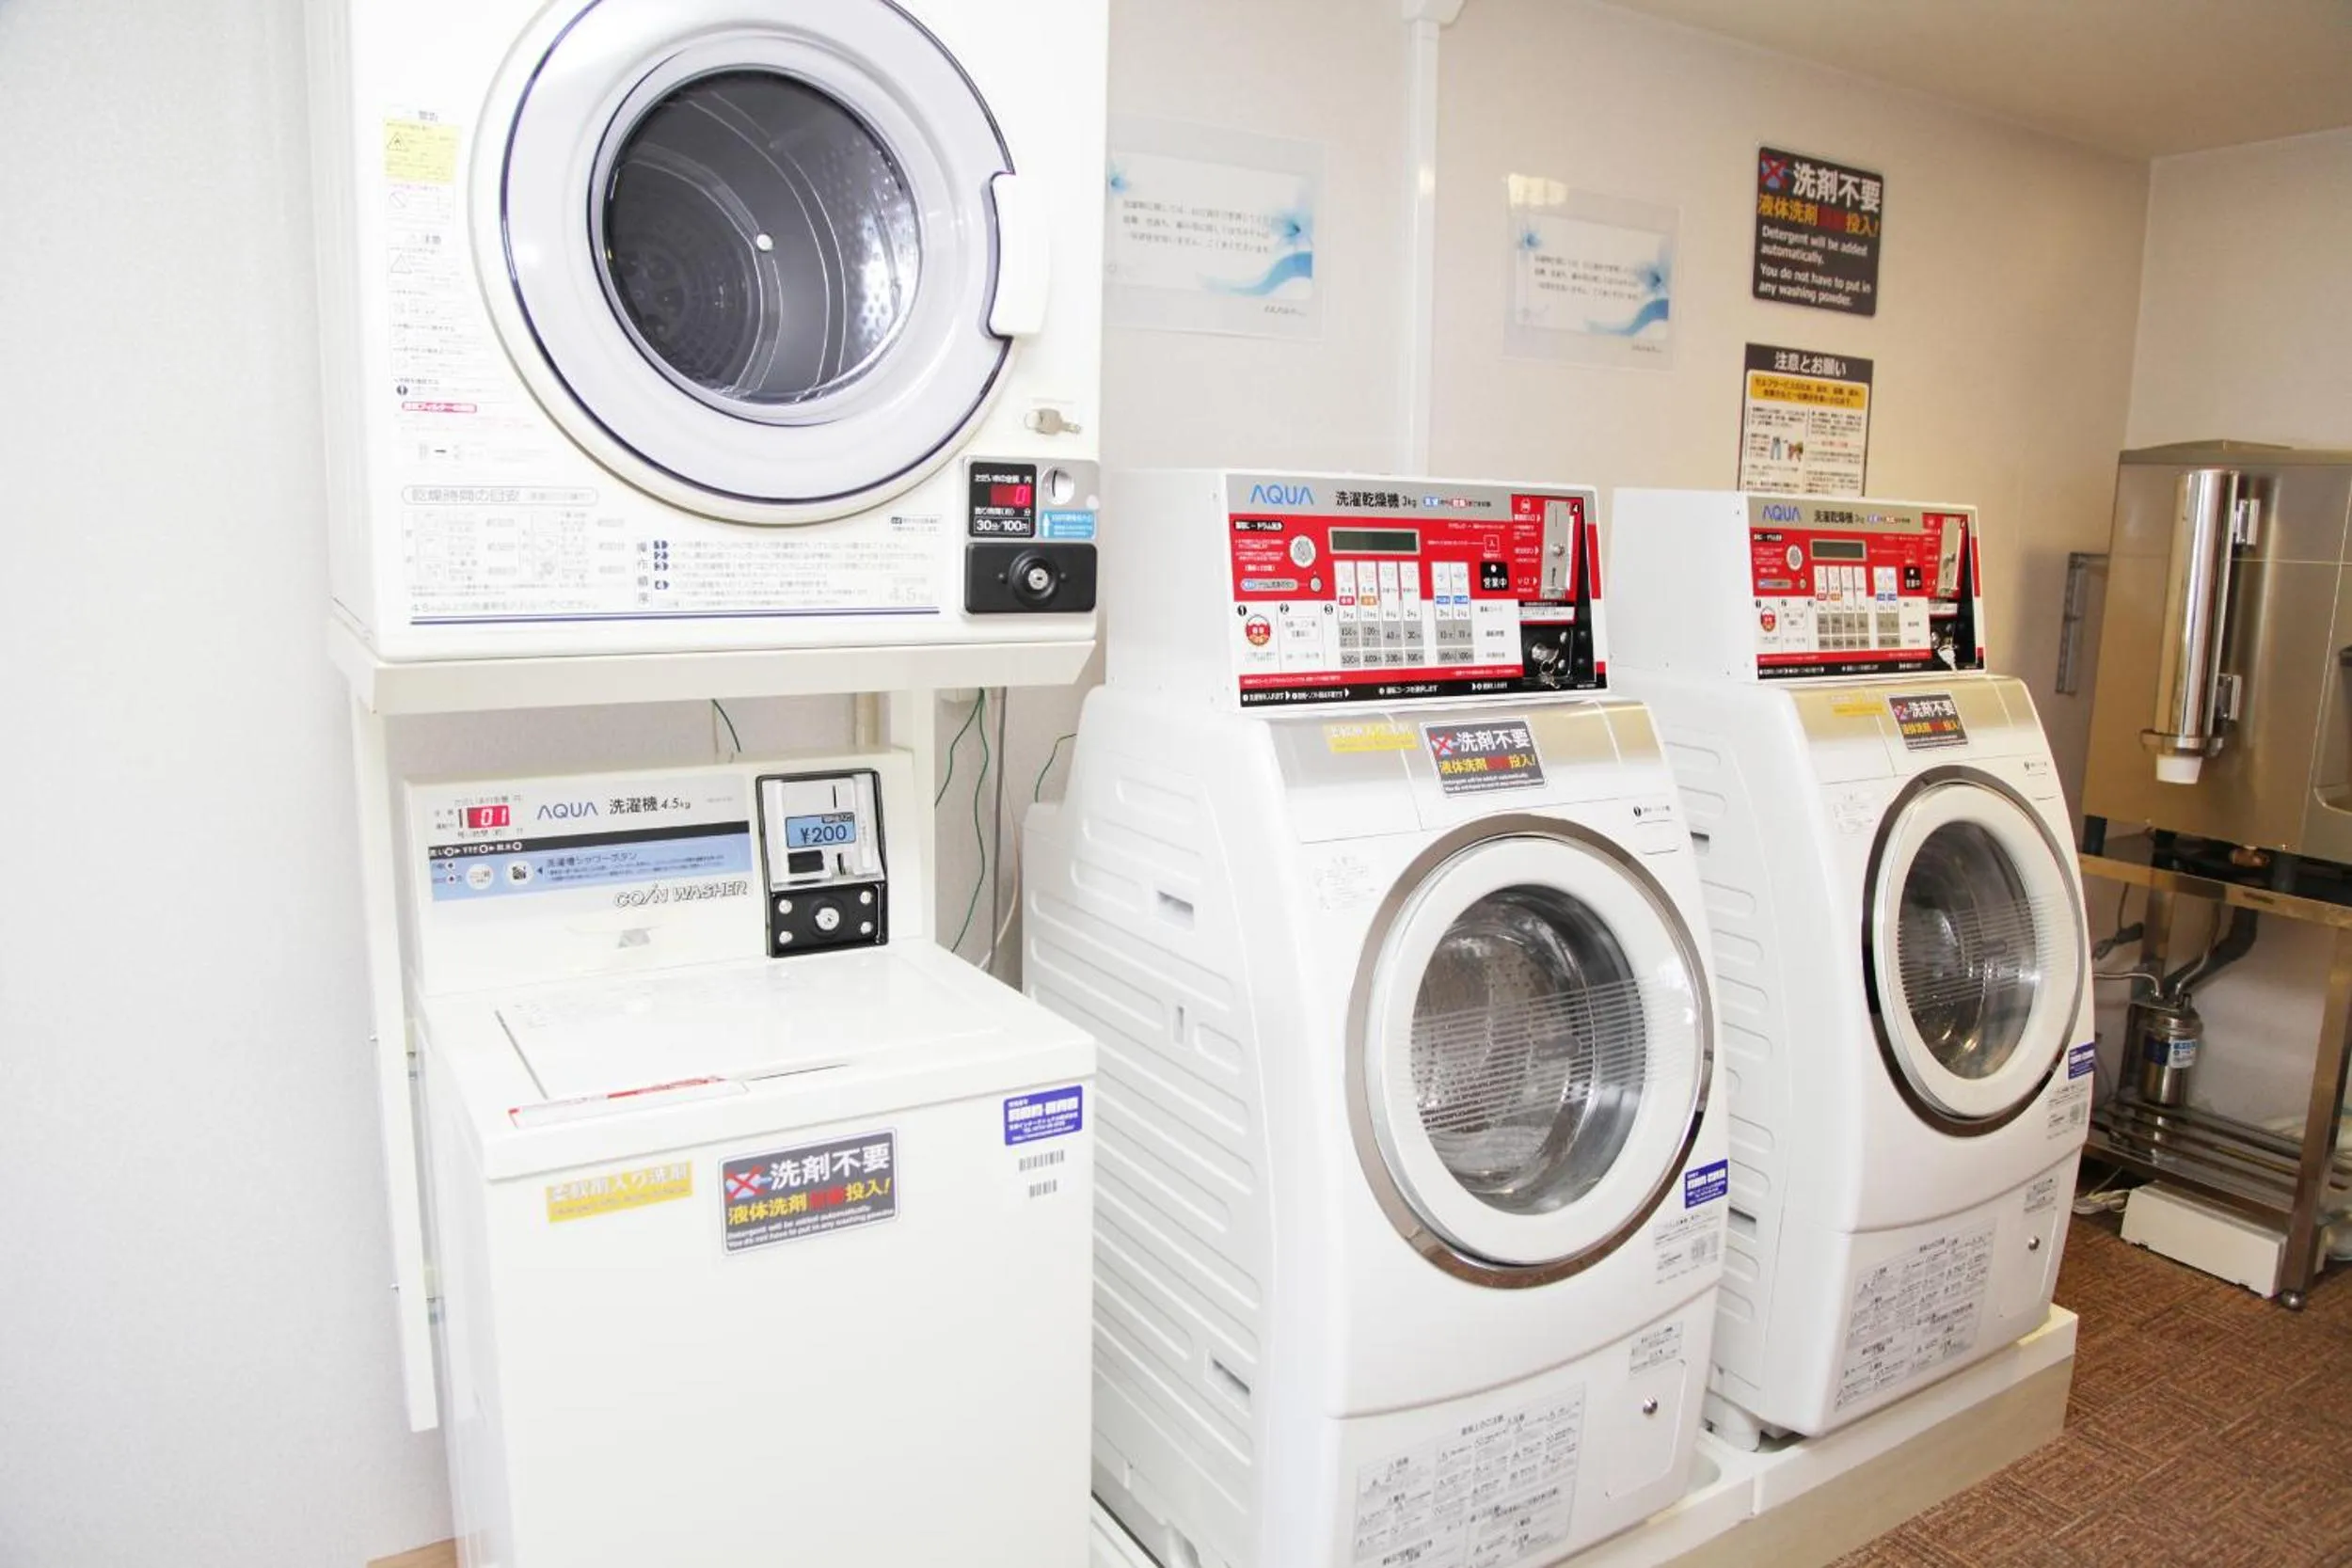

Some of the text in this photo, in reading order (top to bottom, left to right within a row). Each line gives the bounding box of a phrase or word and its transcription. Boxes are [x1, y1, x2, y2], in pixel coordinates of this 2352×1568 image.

[1792, 160, 1882, 213] 洗剤不要
[1758, 193, 1880, 238] 液体洗剤投入!
[1761, 225, 1867, 257] Detergent will be added
[1760, 262, 1871, 293] You do not have to put in
[1758, 281, 1777, 296] any
[1778, 284, 1817, 303] washing
[1774, 351, 1847, 377] 注意とお願い
[1015, 484, 1026, 504] 0
[1250, 483, 1314, 506] AQUA
[1336, 491, 1400, 509] 洗濯乾燥機
[1762, 504, 1802, 523] AQUA
[1456, 728, 1531, 752] 洗剤不要
[537, 796, 691, 820] AQUA 洗濯機 4.5kg
[801, 824, 848, 844] ¥200
[614, 879, 749, 909] COIN WASHER
[770, 1142, 891, 1191] 洗剤不要
[728, 1177, 892, 1226] 液体洗剤投入!
